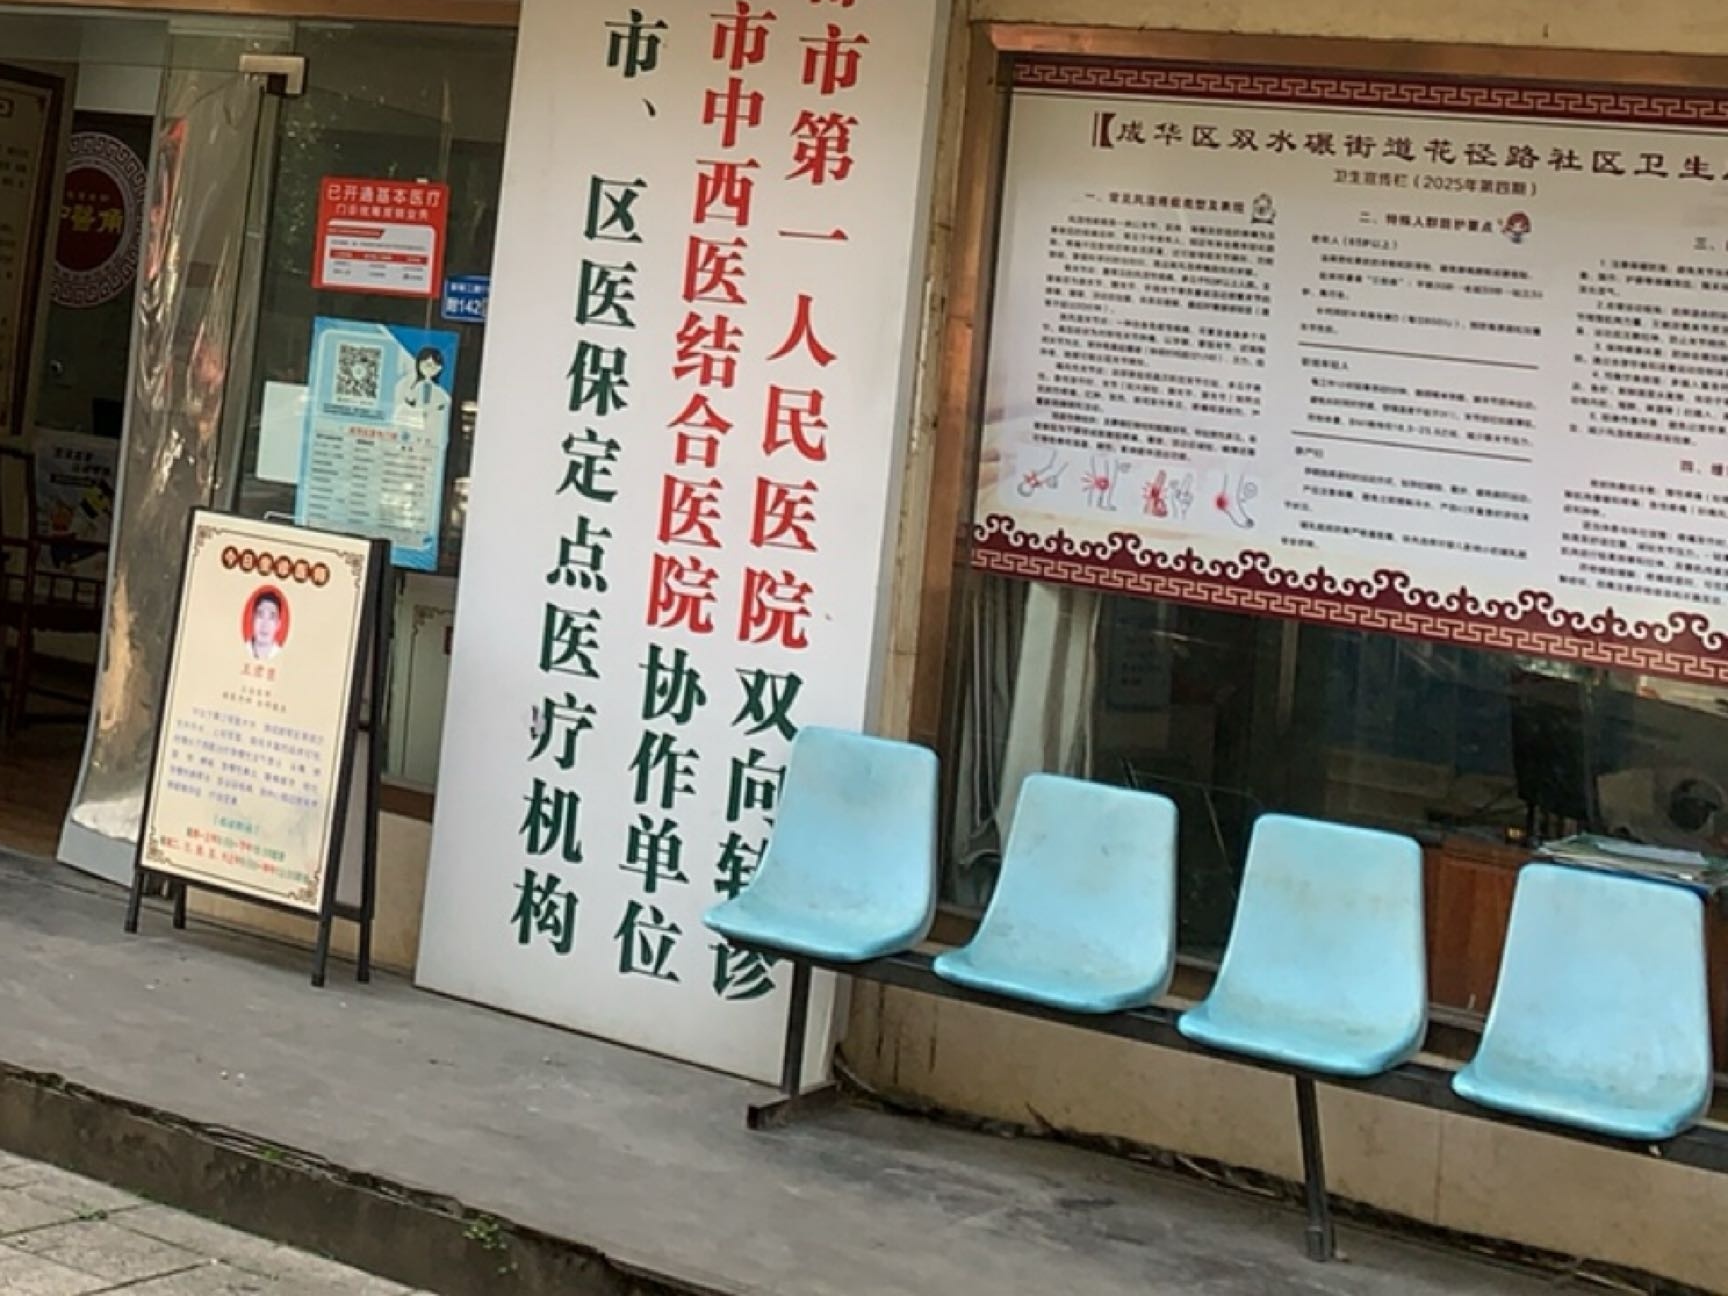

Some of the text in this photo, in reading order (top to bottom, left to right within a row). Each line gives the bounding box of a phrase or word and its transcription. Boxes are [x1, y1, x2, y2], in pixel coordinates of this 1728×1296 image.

[1092, 111, 1728, 181] 【成华区双水碾街道花径路社区卫生
